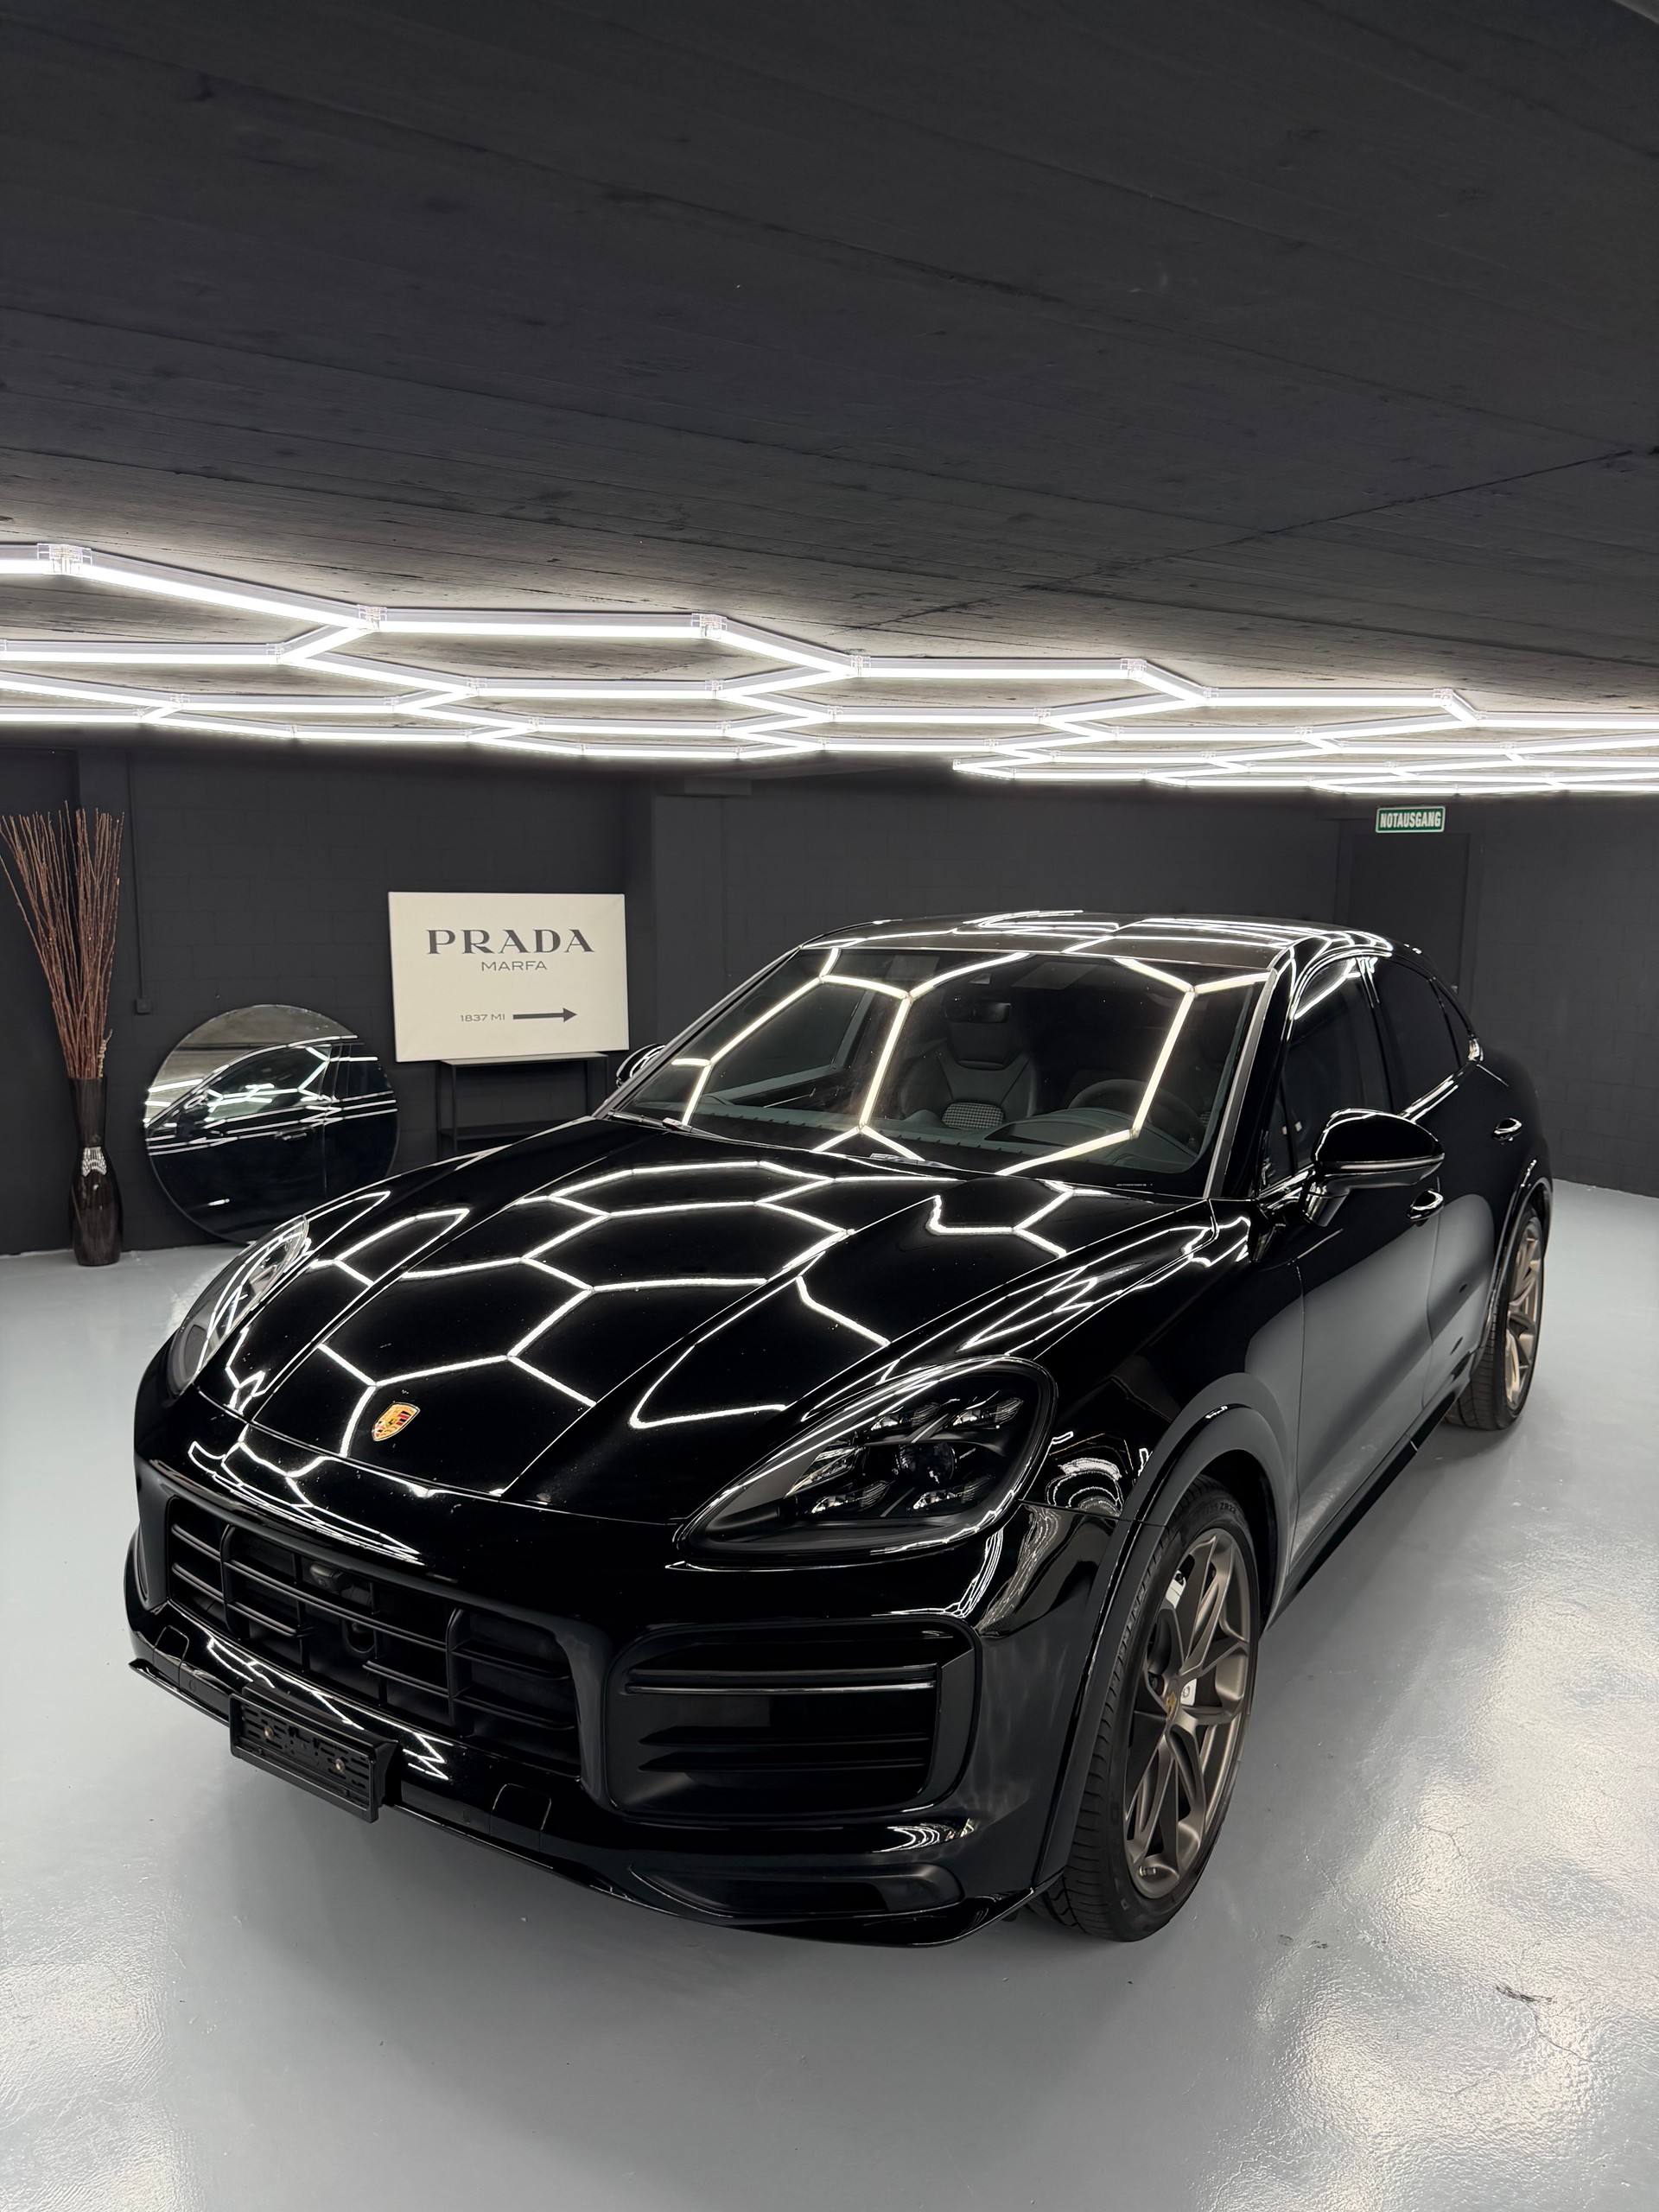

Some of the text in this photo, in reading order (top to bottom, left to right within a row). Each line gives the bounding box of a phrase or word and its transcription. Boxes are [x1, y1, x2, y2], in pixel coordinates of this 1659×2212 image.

[1380, 811, 1441, 828] NOTAUSGANG
[426, 929, 595, 955] PRADA
[481, 960, 548, 972] MARFA
[460, 1014, 488, 1022] 1837
[1220, 1502, 1236, 1515] ZR22
